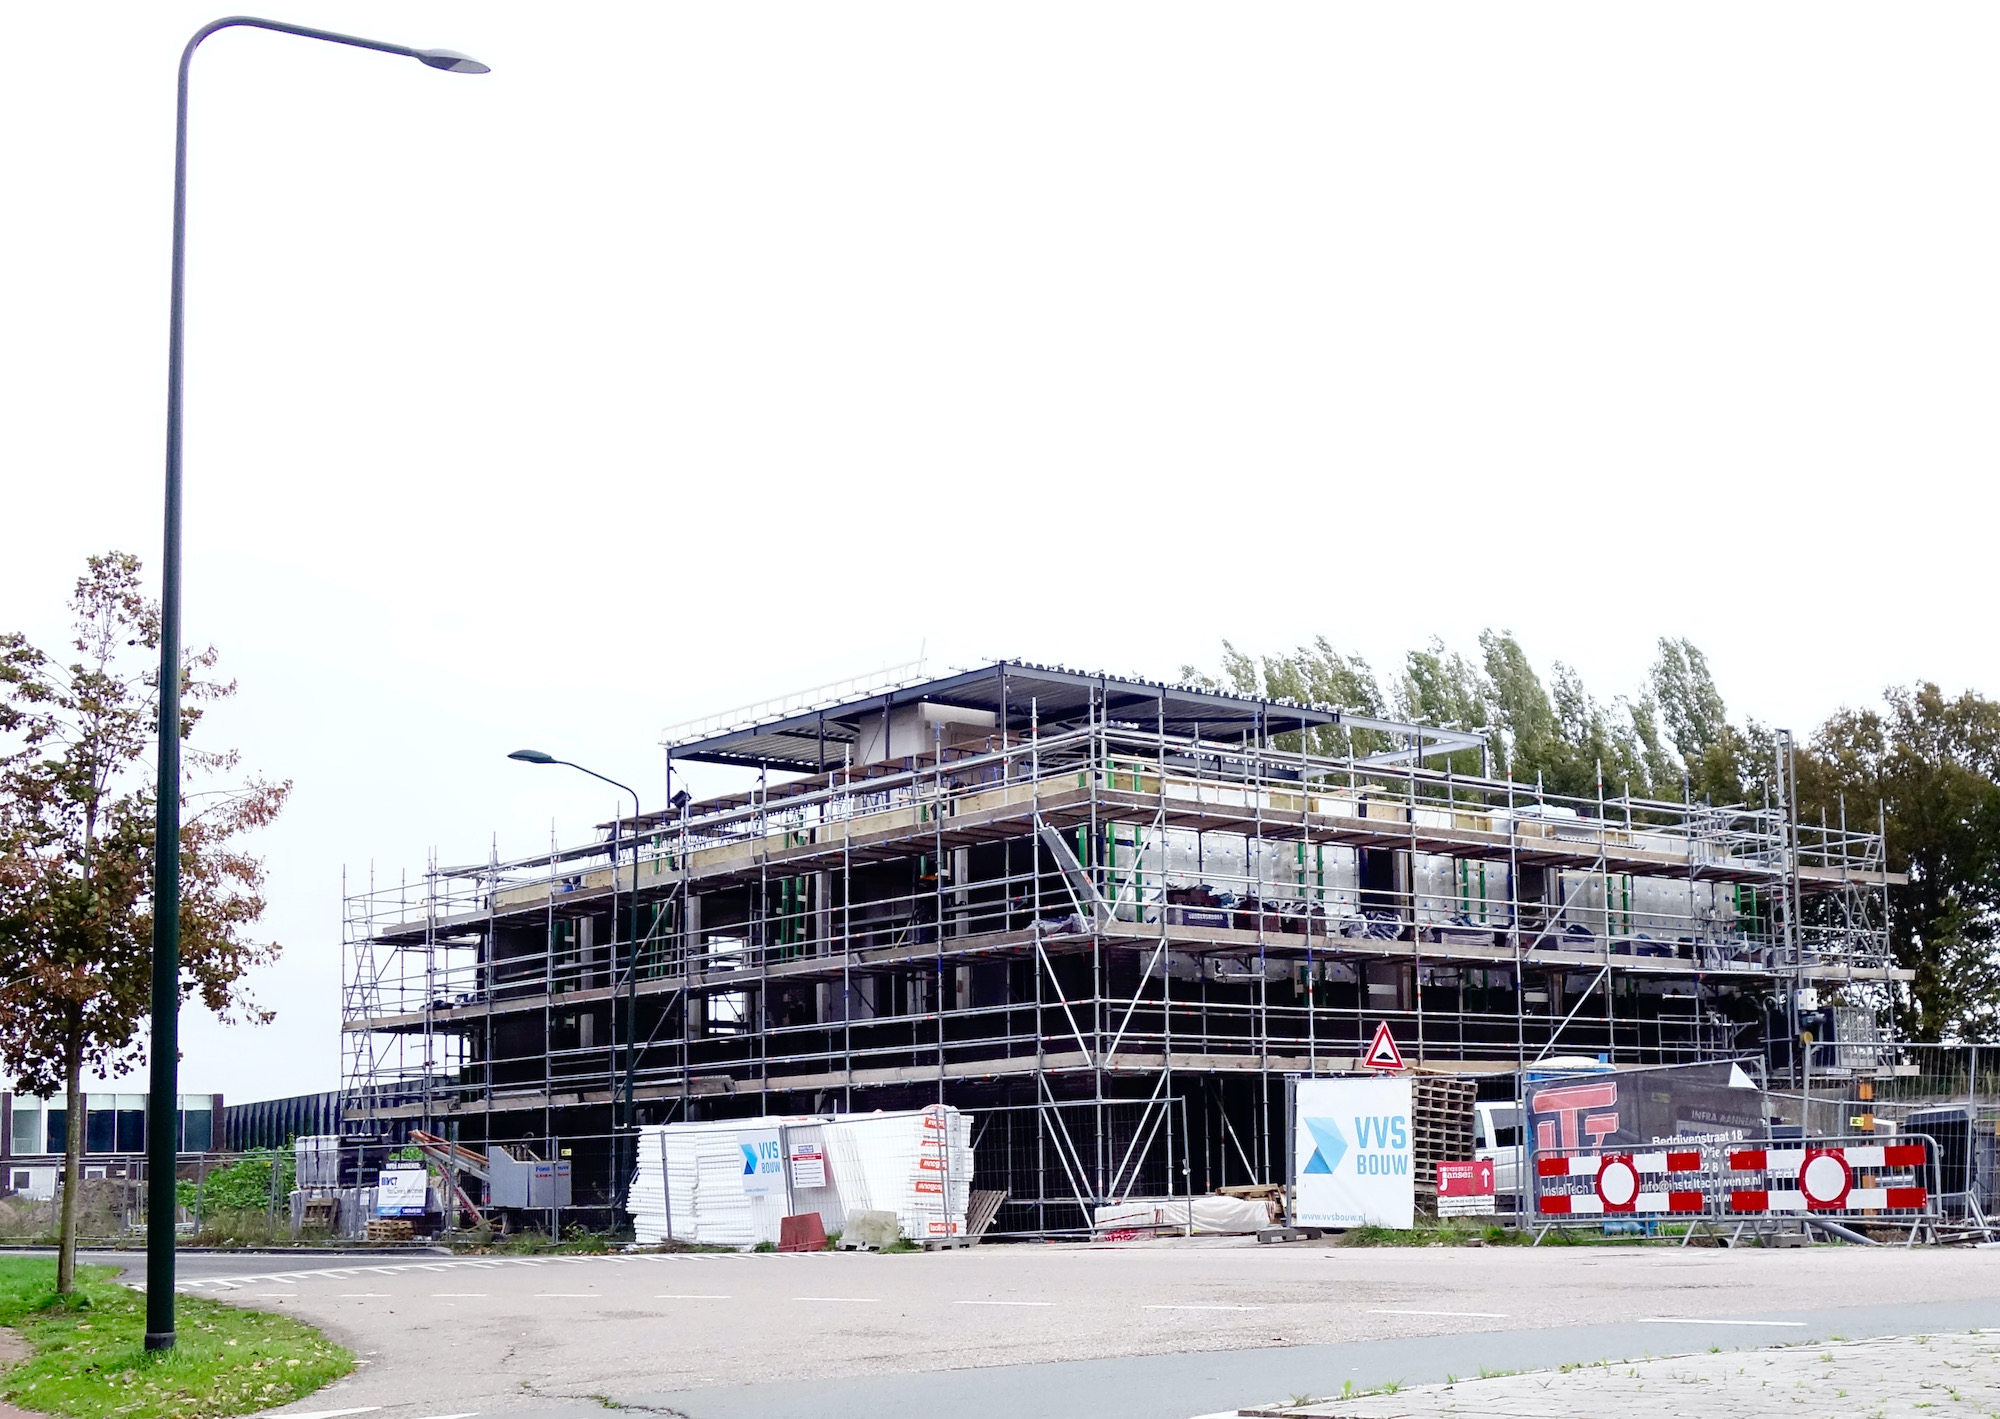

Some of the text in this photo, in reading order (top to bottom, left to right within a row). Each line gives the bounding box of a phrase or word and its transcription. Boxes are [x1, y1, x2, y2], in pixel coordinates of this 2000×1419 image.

[1354, 1115, 1407, 1149] VVS
[1731, 1129, 1744, 1141] 18
[758, 1140, 779, 1160] VVS
[761, 1161, 781, 1174] BOUW
[1356, 1154, 1409, 1176] BOUW
[1301, 1213, 1366, 1222] www.vvsbouw.nl
